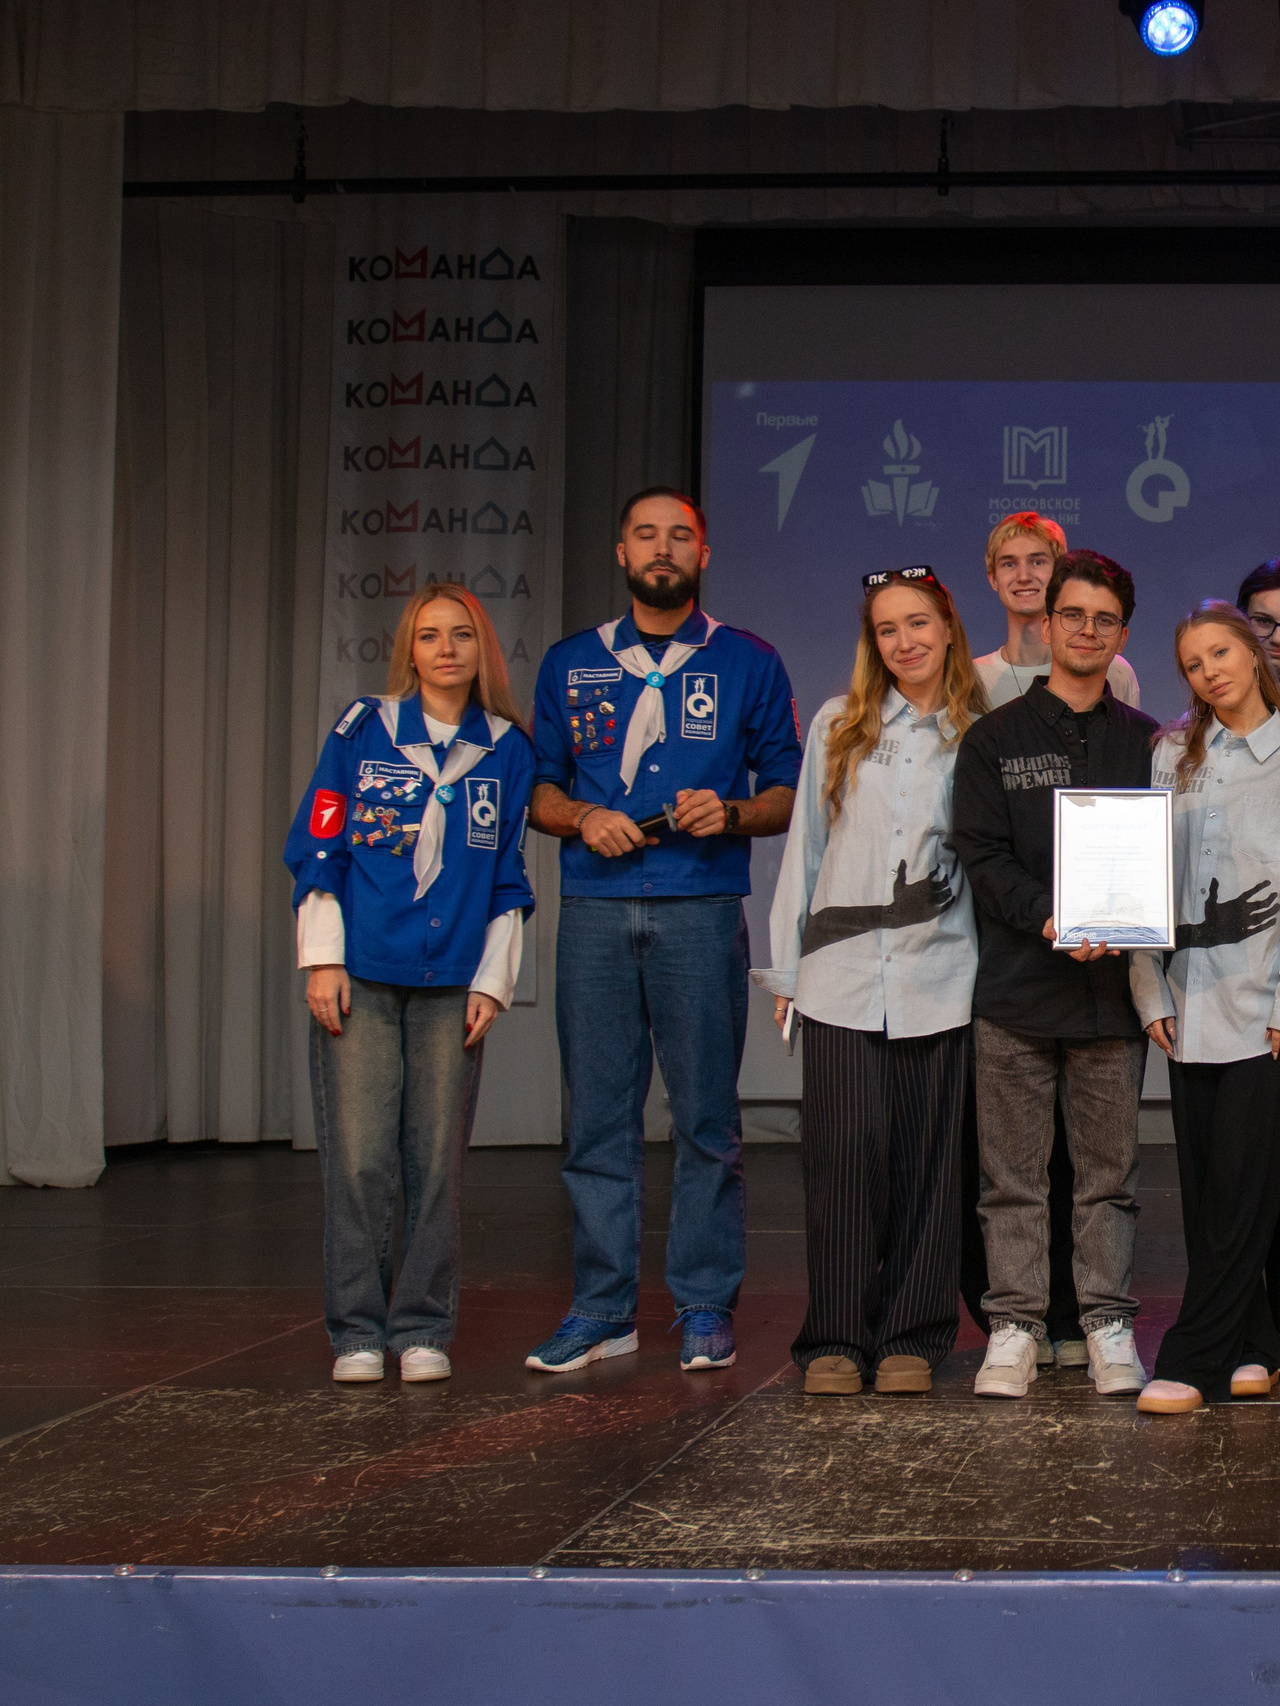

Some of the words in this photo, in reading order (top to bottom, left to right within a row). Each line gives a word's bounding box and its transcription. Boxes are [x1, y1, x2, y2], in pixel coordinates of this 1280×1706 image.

[349, 245, 540, 281] КОМАНДА
[347, 308, 539, 344] КОМАНДА
[345, 371, 537, 407] КОМАНДА
[757, 411, 818, 431] Первые
[343, 435, 535, 471] КОМАНДА
[341, 499, 533, 535] КОМАНДА
[989, 498, 1080, 510] МОСКОВСКОЕ
